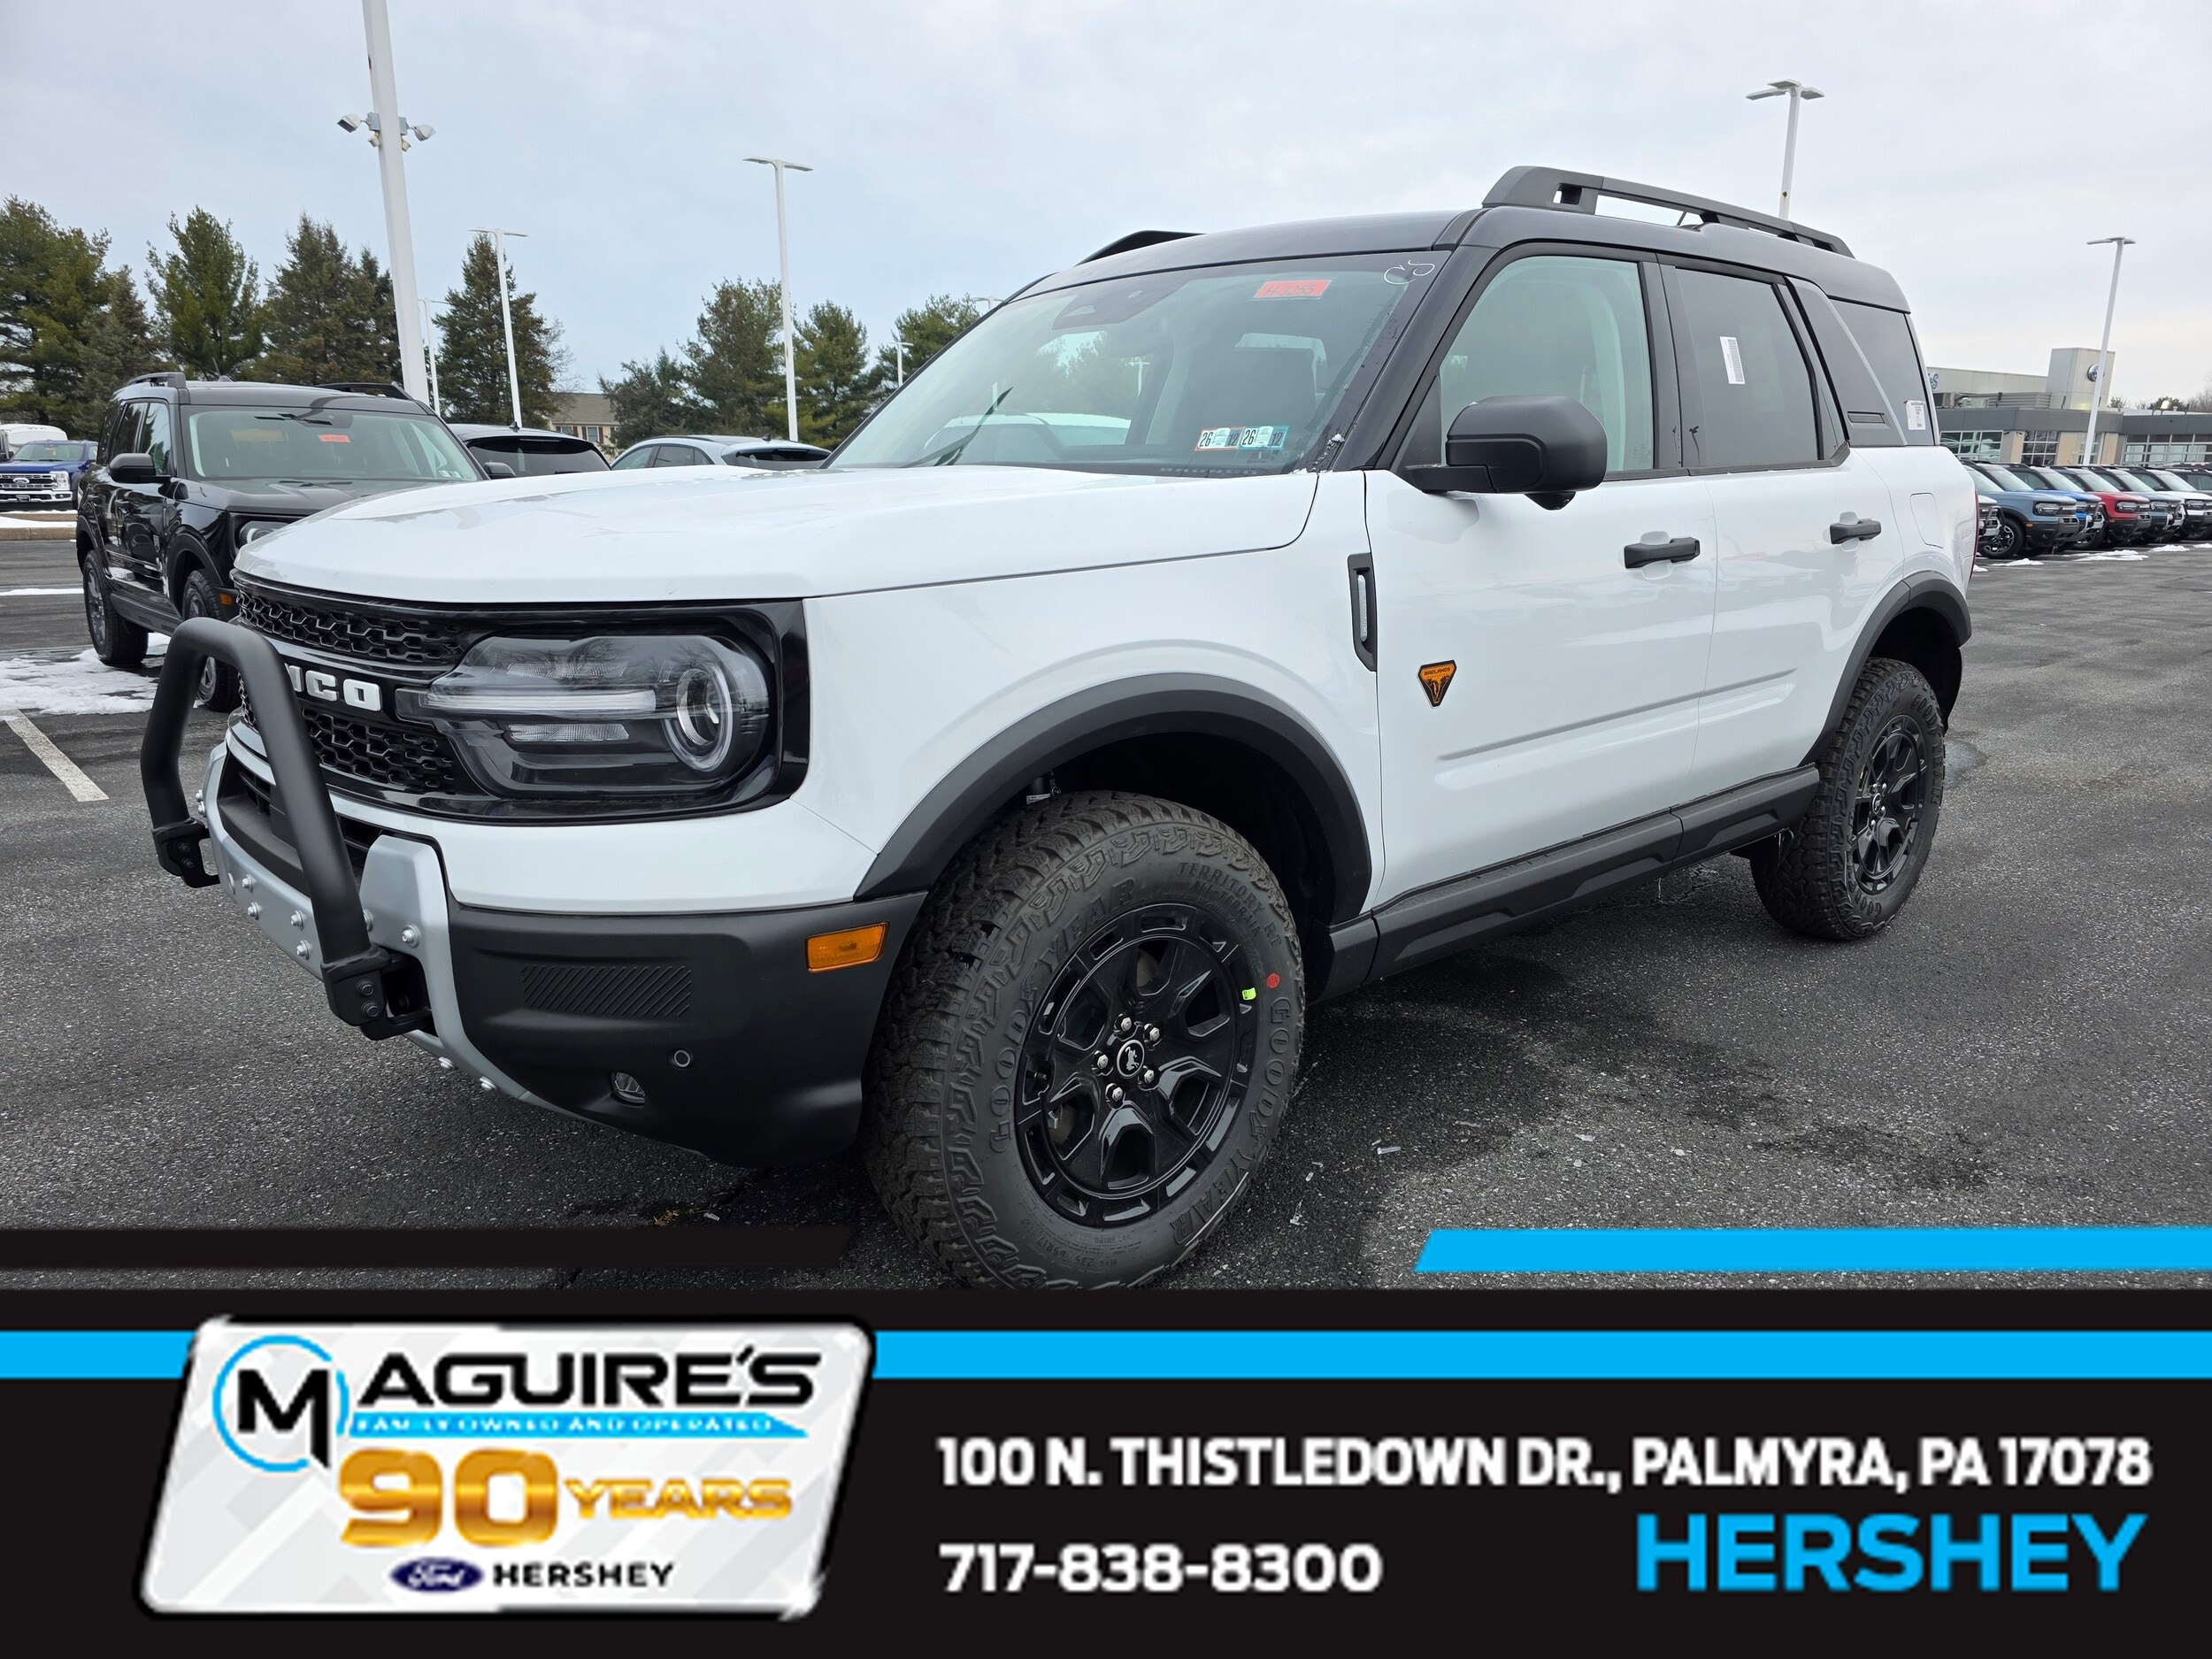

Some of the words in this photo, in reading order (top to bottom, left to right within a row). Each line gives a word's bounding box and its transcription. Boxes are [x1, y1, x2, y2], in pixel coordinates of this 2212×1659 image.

[1199, 431, 1213, 448] 26
[1227, 432, 1240, 448] 12
[1241, 429, 1256, 446] 26
[1271, 431, 1284, 447] 12
[1424, 666, 1451, 676] BADLANDS
[1177, 861, 1265, 918] TERRITORY
